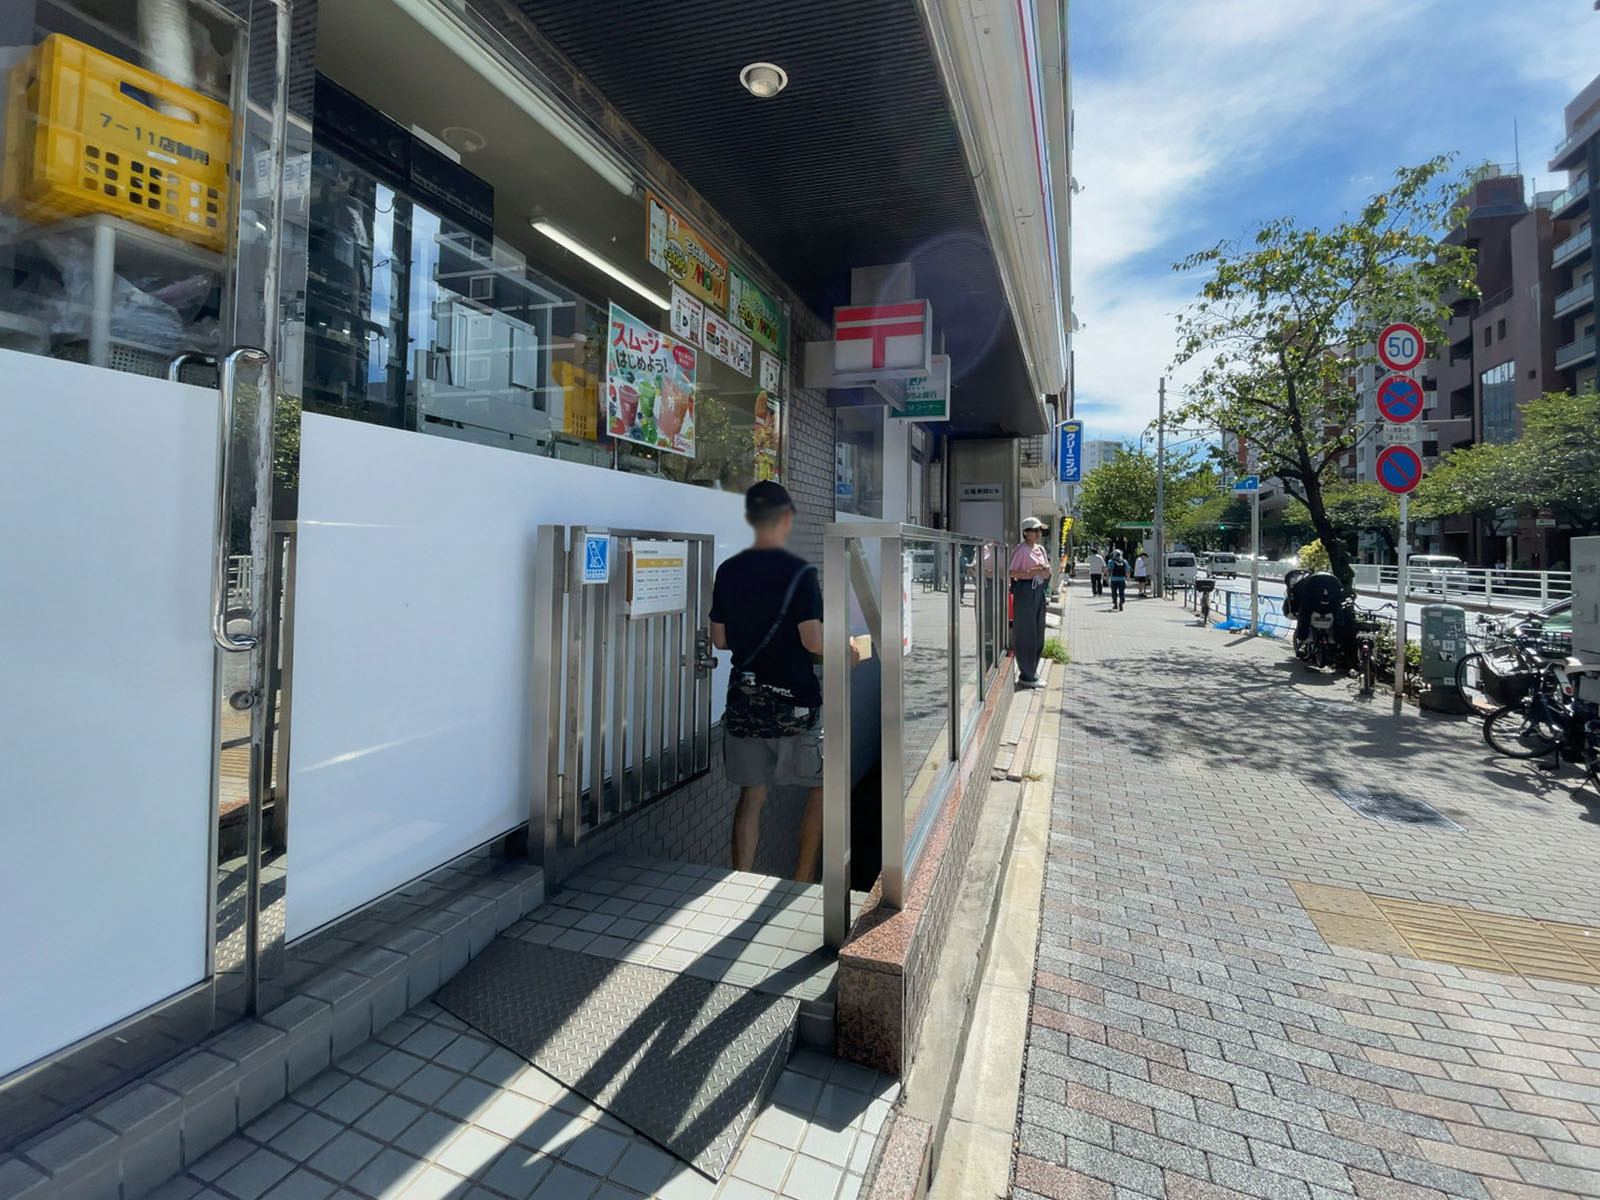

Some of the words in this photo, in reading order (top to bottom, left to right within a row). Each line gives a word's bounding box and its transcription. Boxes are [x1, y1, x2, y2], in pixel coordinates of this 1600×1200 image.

[611, 322, 670, 355] スムージー
[1388, 337, 1414, 358] 50
[1065, 432, 1078, 477] クリーニング
